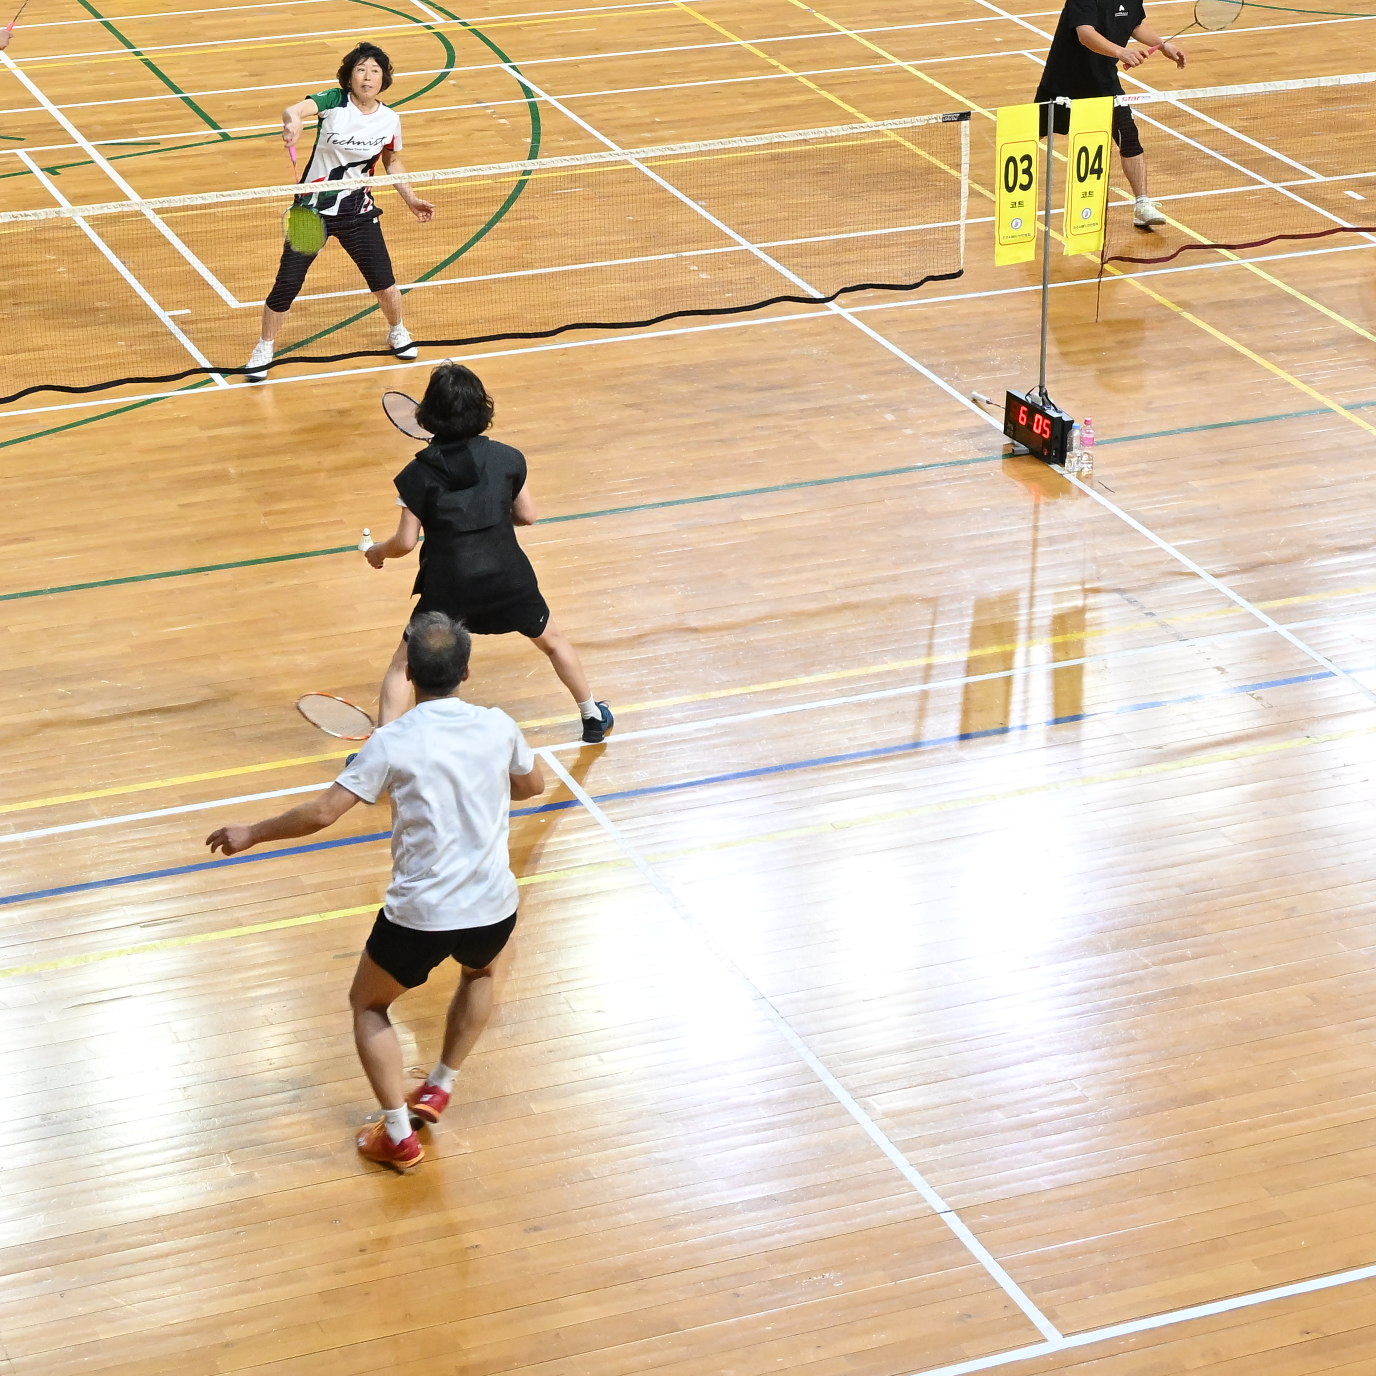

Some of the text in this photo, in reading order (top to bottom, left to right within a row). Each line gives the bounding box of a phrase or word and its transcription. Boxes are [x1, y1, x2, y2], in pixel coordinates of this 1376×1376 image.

[326, 132, 387, 145] Technist
[1004, 153, 1033, 193] 03
[1077, 144, 1103, 183] 04
[1018, 405, 1051, 438] 6 05
